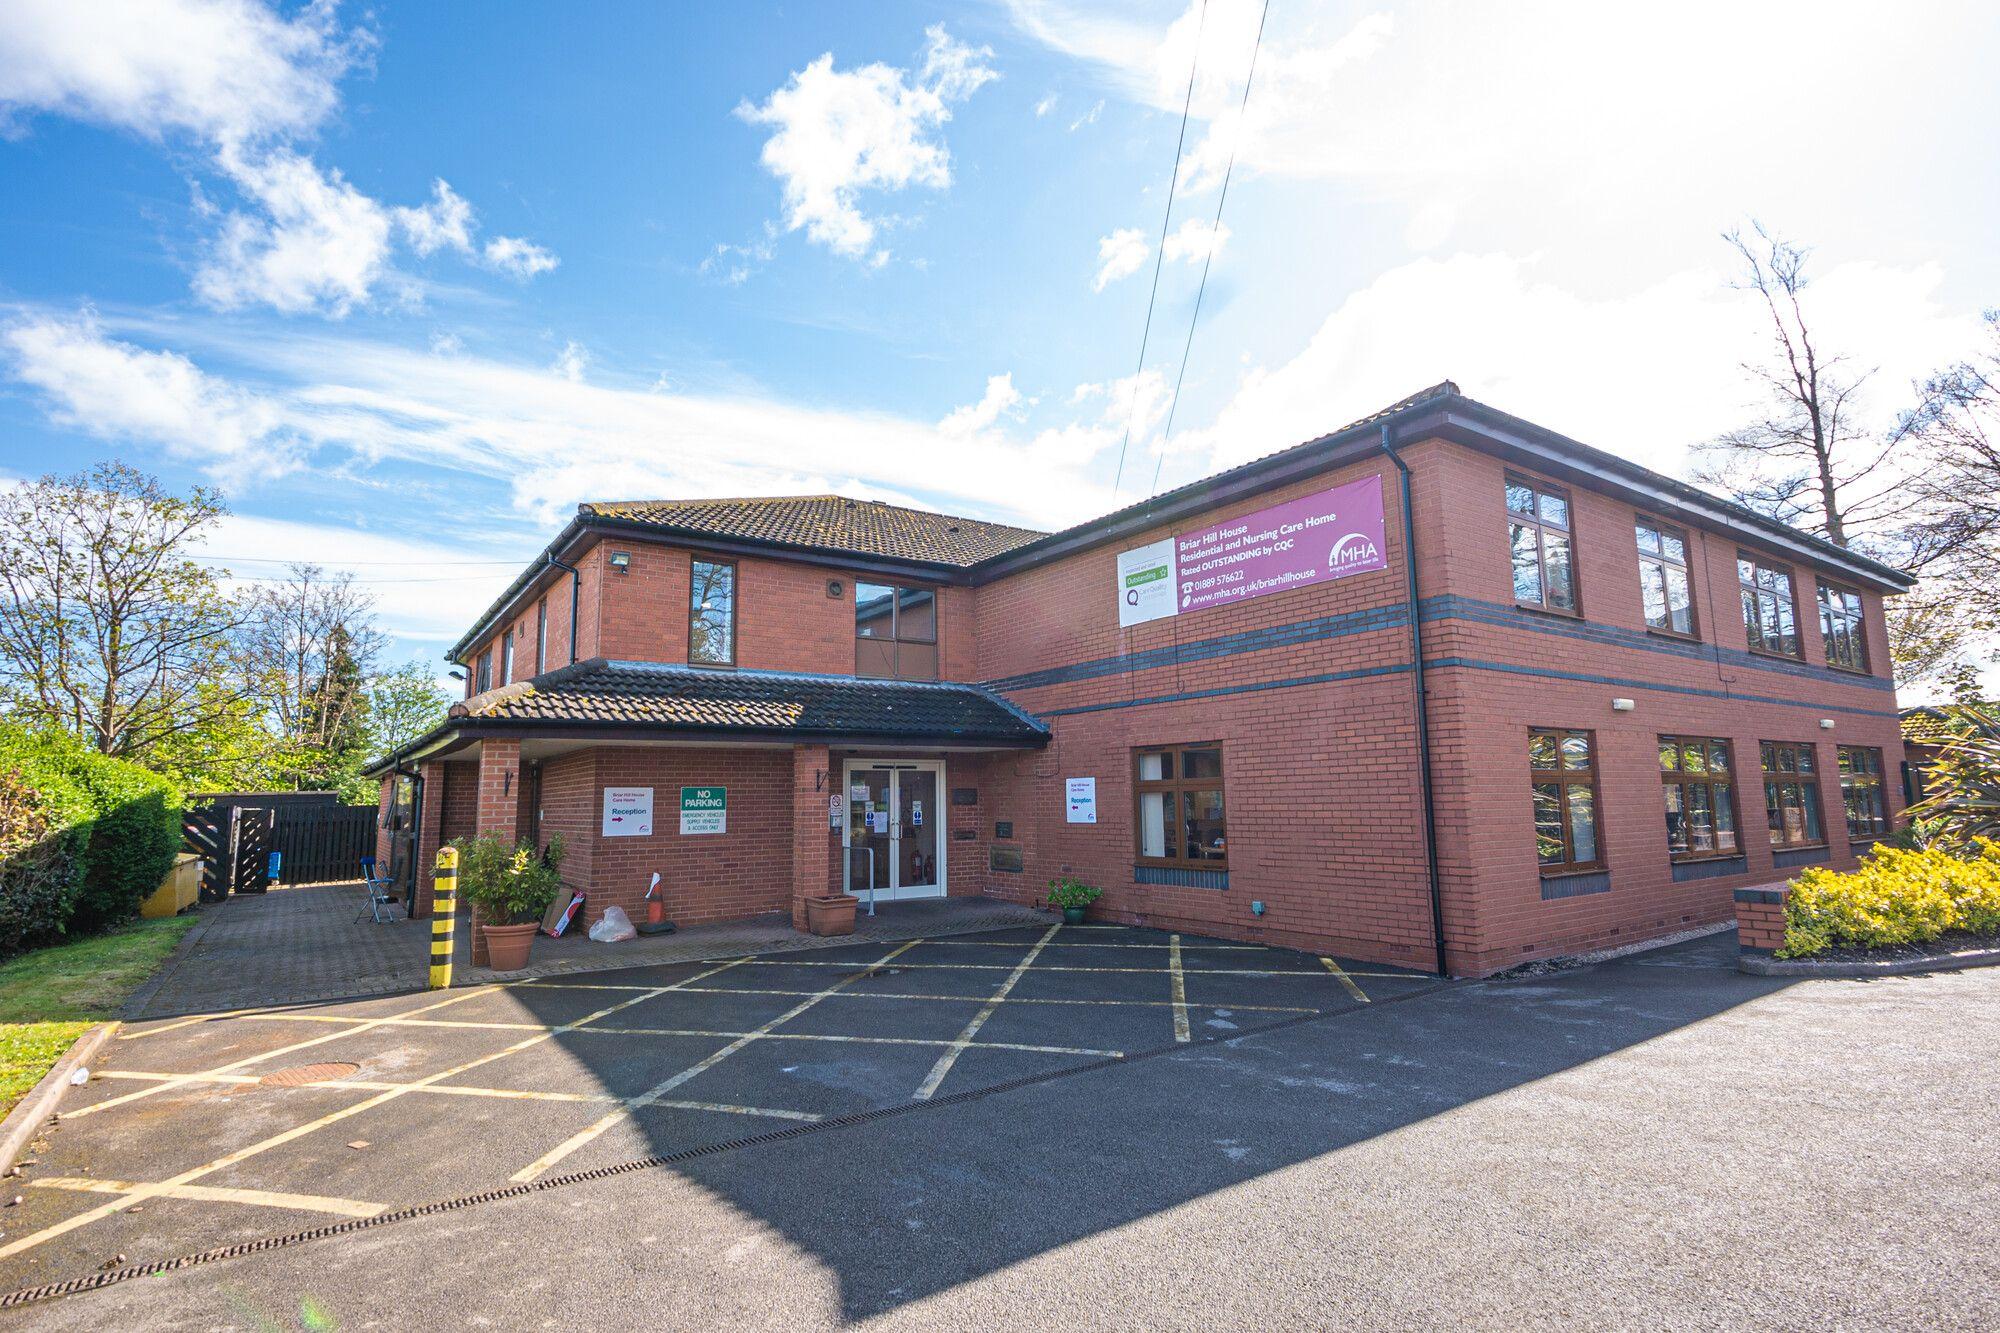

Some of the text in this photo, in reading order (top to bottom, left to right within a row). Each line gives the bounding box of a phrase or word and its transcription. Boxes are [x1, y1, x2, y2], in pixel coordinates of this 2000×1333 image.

[1180, 525, 1248, 551] Briar Hill House
[1180, 513, 1337, 563] Residential and Nursing Care Home
[1181, 539, 1294, 576] Rated OUTSTANDING by CQC
[1341, 542, 1378, 563] MHA
[1127, 572, 1156, 585] Outstanding
[1192, 569, 1316, 604] www.mha.org.uk/briarhillhouse
[1194, 570, 1245, 591] 01889 576622
[685, 799, 722, 807] PARKING
[697, 790, 710, 798] NO
